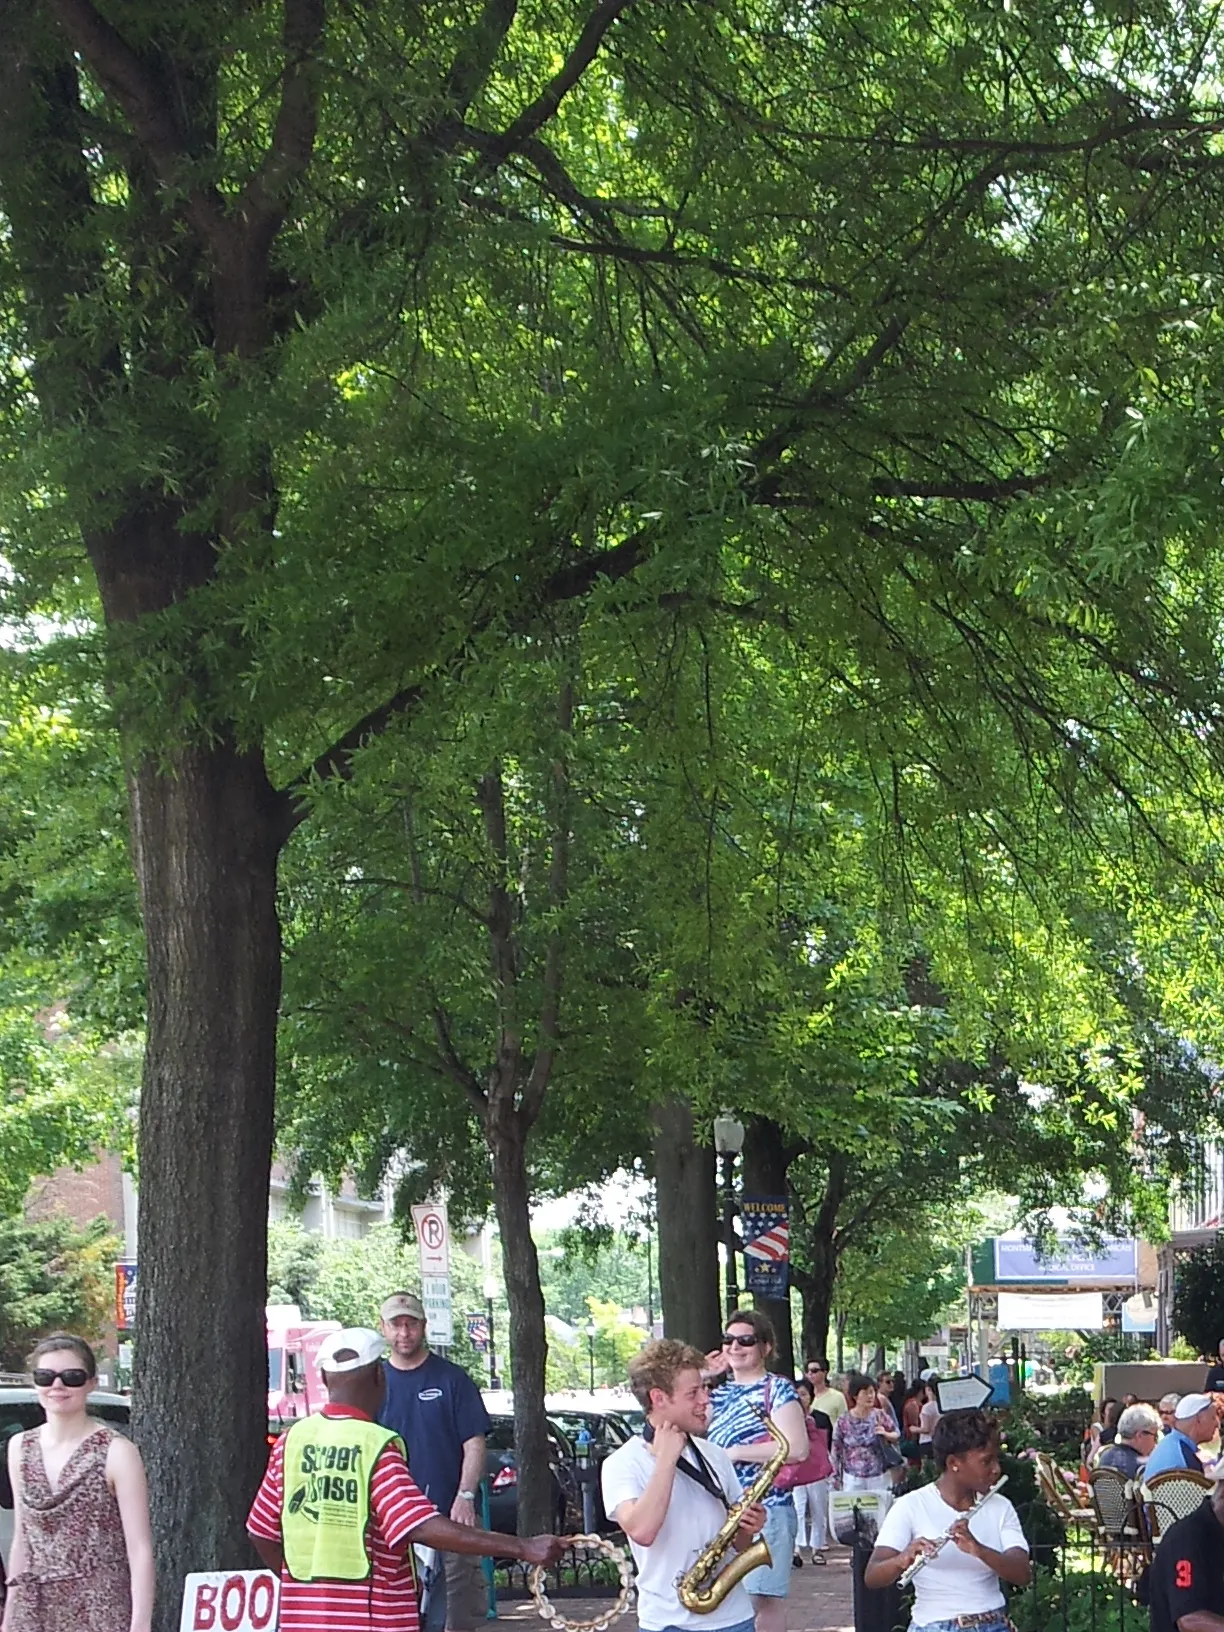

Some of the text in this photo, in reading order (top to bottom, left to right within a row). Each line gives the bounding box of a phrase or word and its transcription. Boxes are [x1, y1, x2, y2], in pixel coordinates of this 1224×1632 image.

[743, 1203, 785, 1213] WELCOME
[1072, 1263, 1095, 1271] OFFICE
[301, 1444, 362, 1473] Street
[1176, 1560, 1191, 1587] 3
[193, 1574, 275, 1632] BOO
